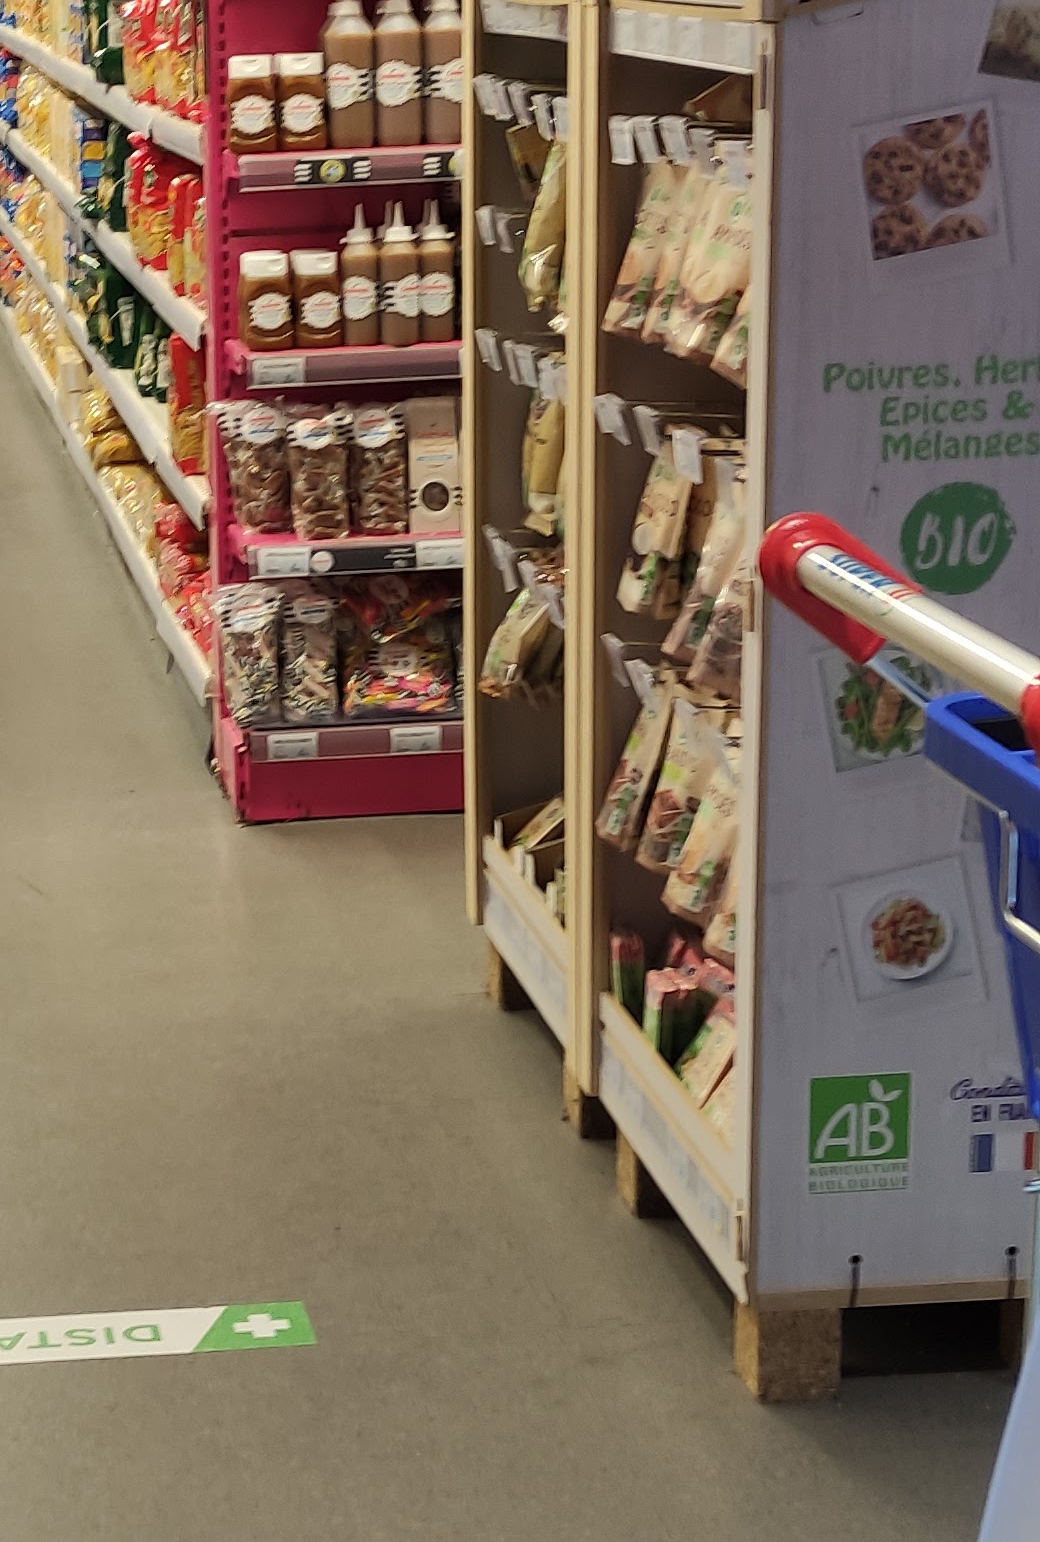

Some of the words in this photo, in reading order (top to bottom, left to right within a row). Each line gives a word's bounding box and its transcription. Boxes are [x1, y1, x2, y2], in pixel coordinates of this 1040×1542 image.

[880, 392, 988, 427] Epices
[1003, 389, 1035, 420] &
[881, 427, 1040, 463] Mélanges
[915, 512, 999, 570] BIO
[814, 1101, 895, 1159] AB
